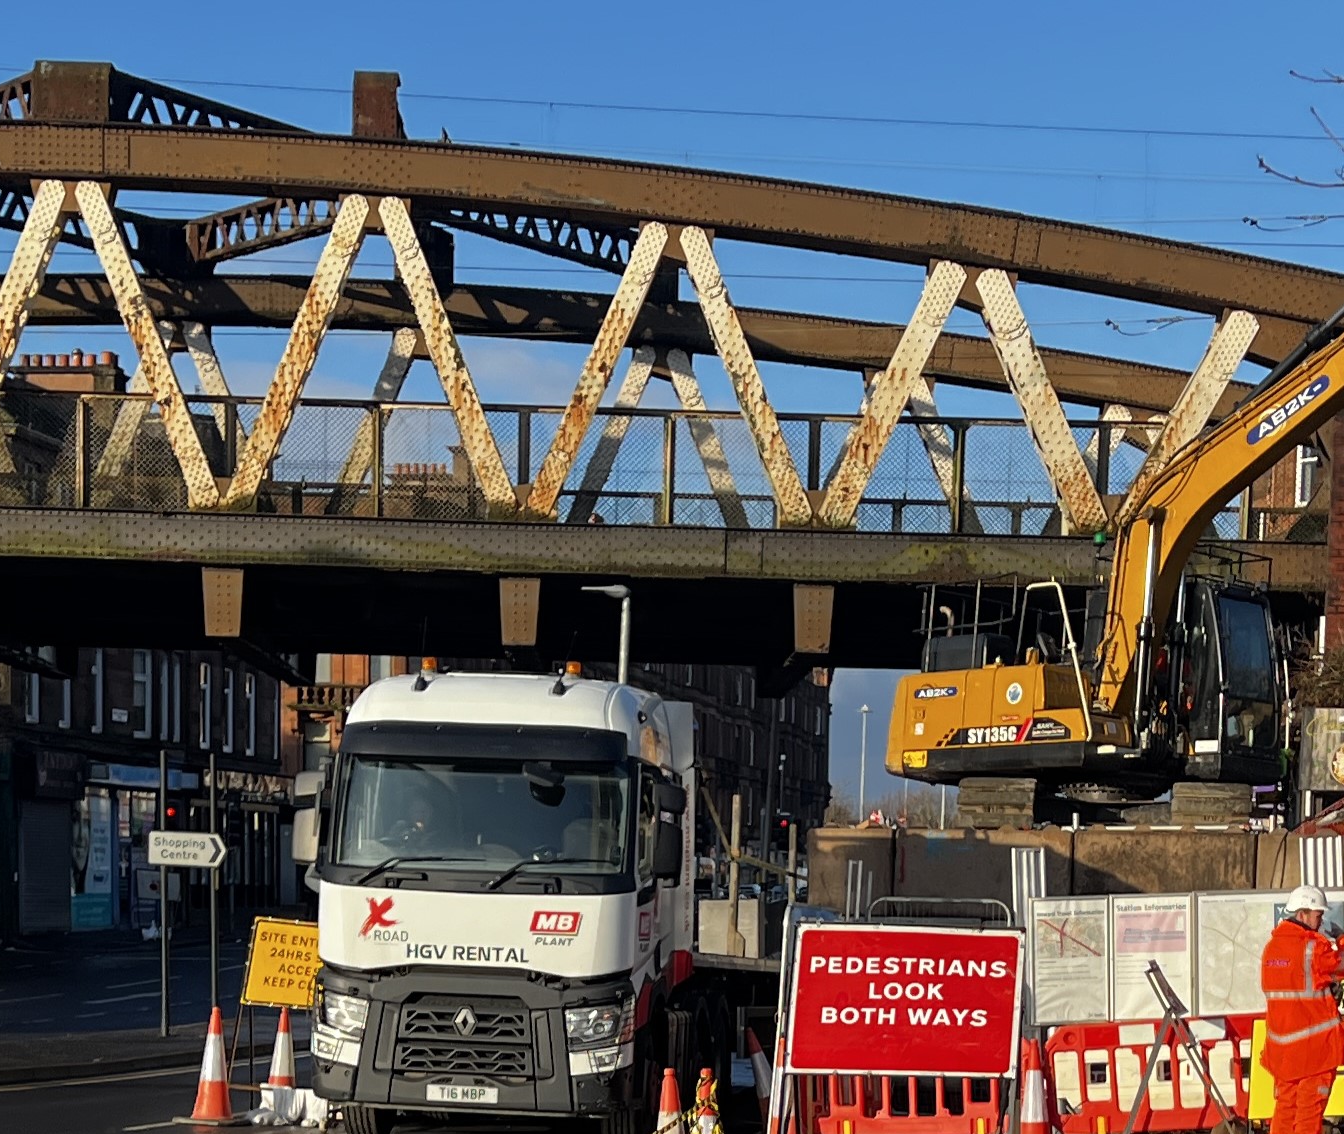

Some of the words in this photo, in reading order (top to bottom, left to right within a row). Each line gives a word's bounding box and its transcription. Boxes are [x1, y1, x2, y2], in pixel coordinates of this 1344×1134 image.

[967, 725, 1018, 744] SY135C
[154, 837, 206, 849] Shopping
[160, 849, 198, 859] Centre
[1116, 904, 1142, 912] Station
[1144, 903, 1187, 911] Information
[535, 913, 575, 931] MB
[260, 931, 287, 944] SITE
[291, 935, 318, 948] ENT
[373, 930, 409, 942] ROAD
[534, 937, 574, 946] PLANT
[269, 947, 312, 961] 24HRS
[406, 943, 447, 960] HGV
[452, 945, 530, 963] RENTAL
[809, 956, 1008, 980] PEDESTRIANS
[262, 976, 295, 988] KEEP
[867, 981, 944, 1002] LOOK
[819, 1005, 899, 1028] BOTH
[907, 1006, 989, 1029] WAYS
[439, 1086, 458, 1099] T16
[461, 1087, 486, 1099] MBP
